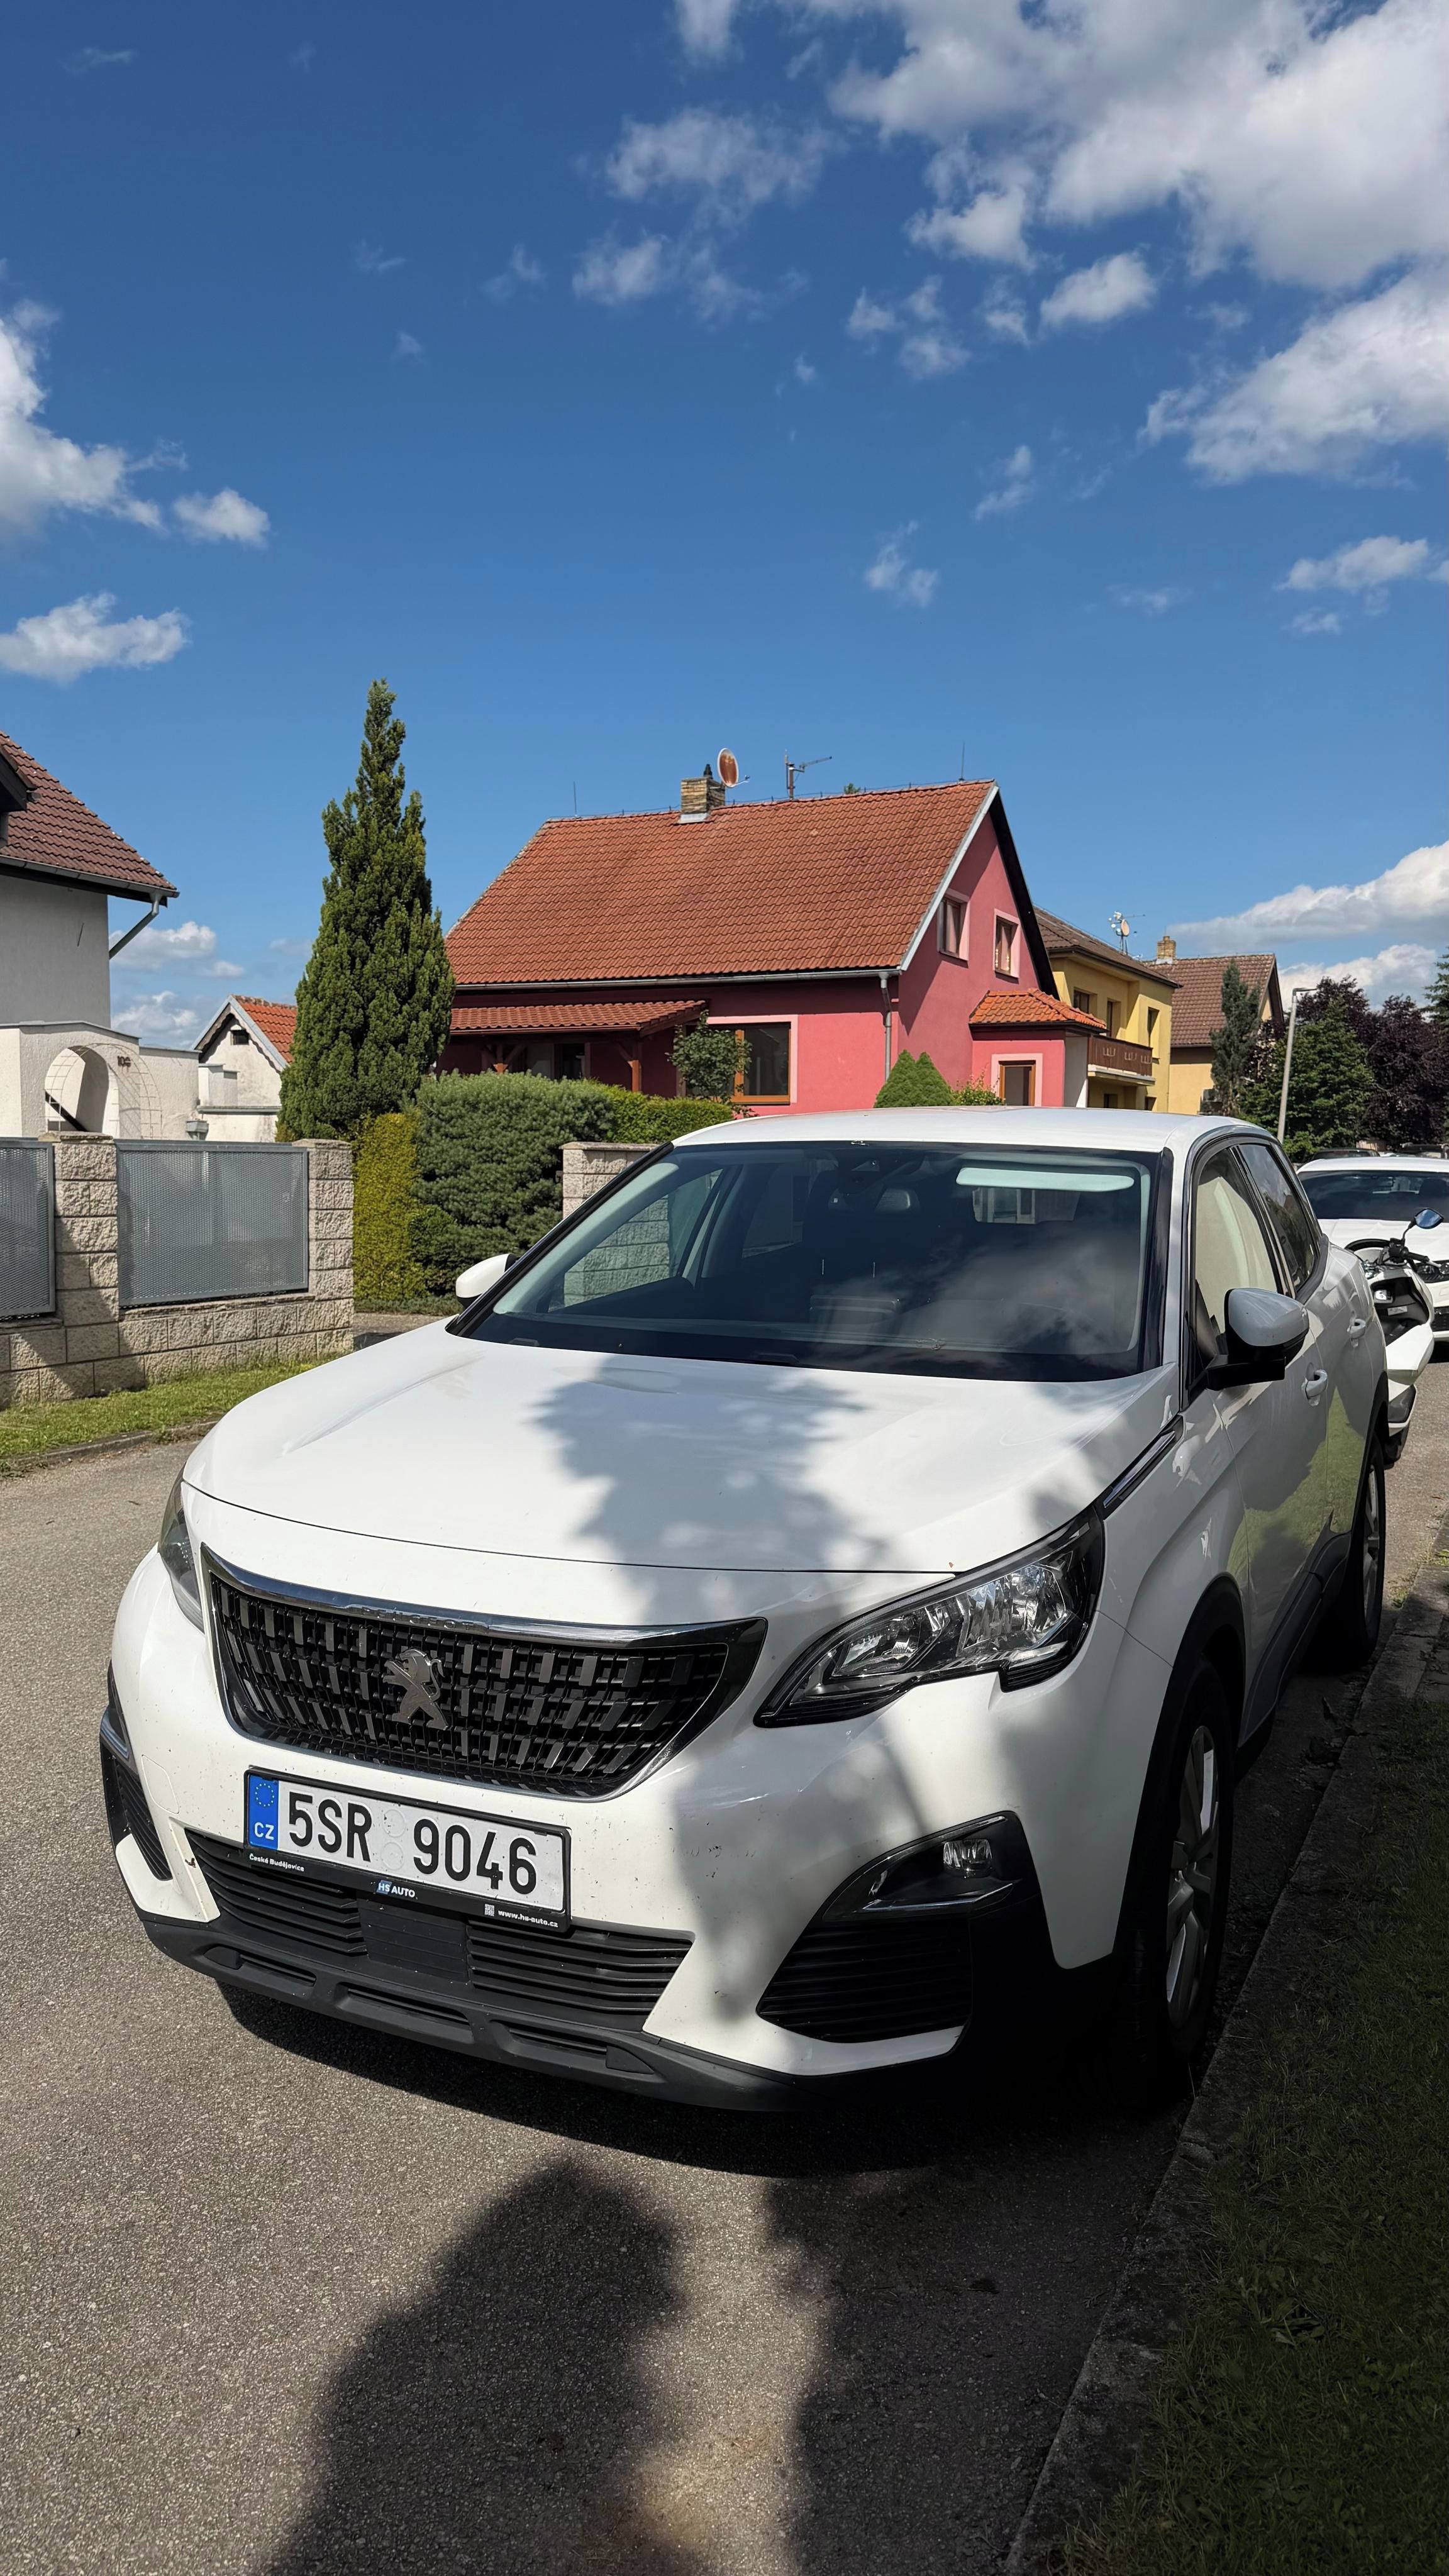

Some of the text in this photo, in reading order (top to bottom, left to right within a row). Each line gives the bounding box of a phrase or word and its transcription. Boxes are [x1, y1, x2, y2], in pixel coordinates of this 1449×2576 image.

[254, 1822, 274, 1840] CZ
[289, 1791, 536, 1895] 5SR 9046
[378, 1882, 416, 1898] HS AUTO
[497, 1910, 558, 1928] www.hs-auto.cz
